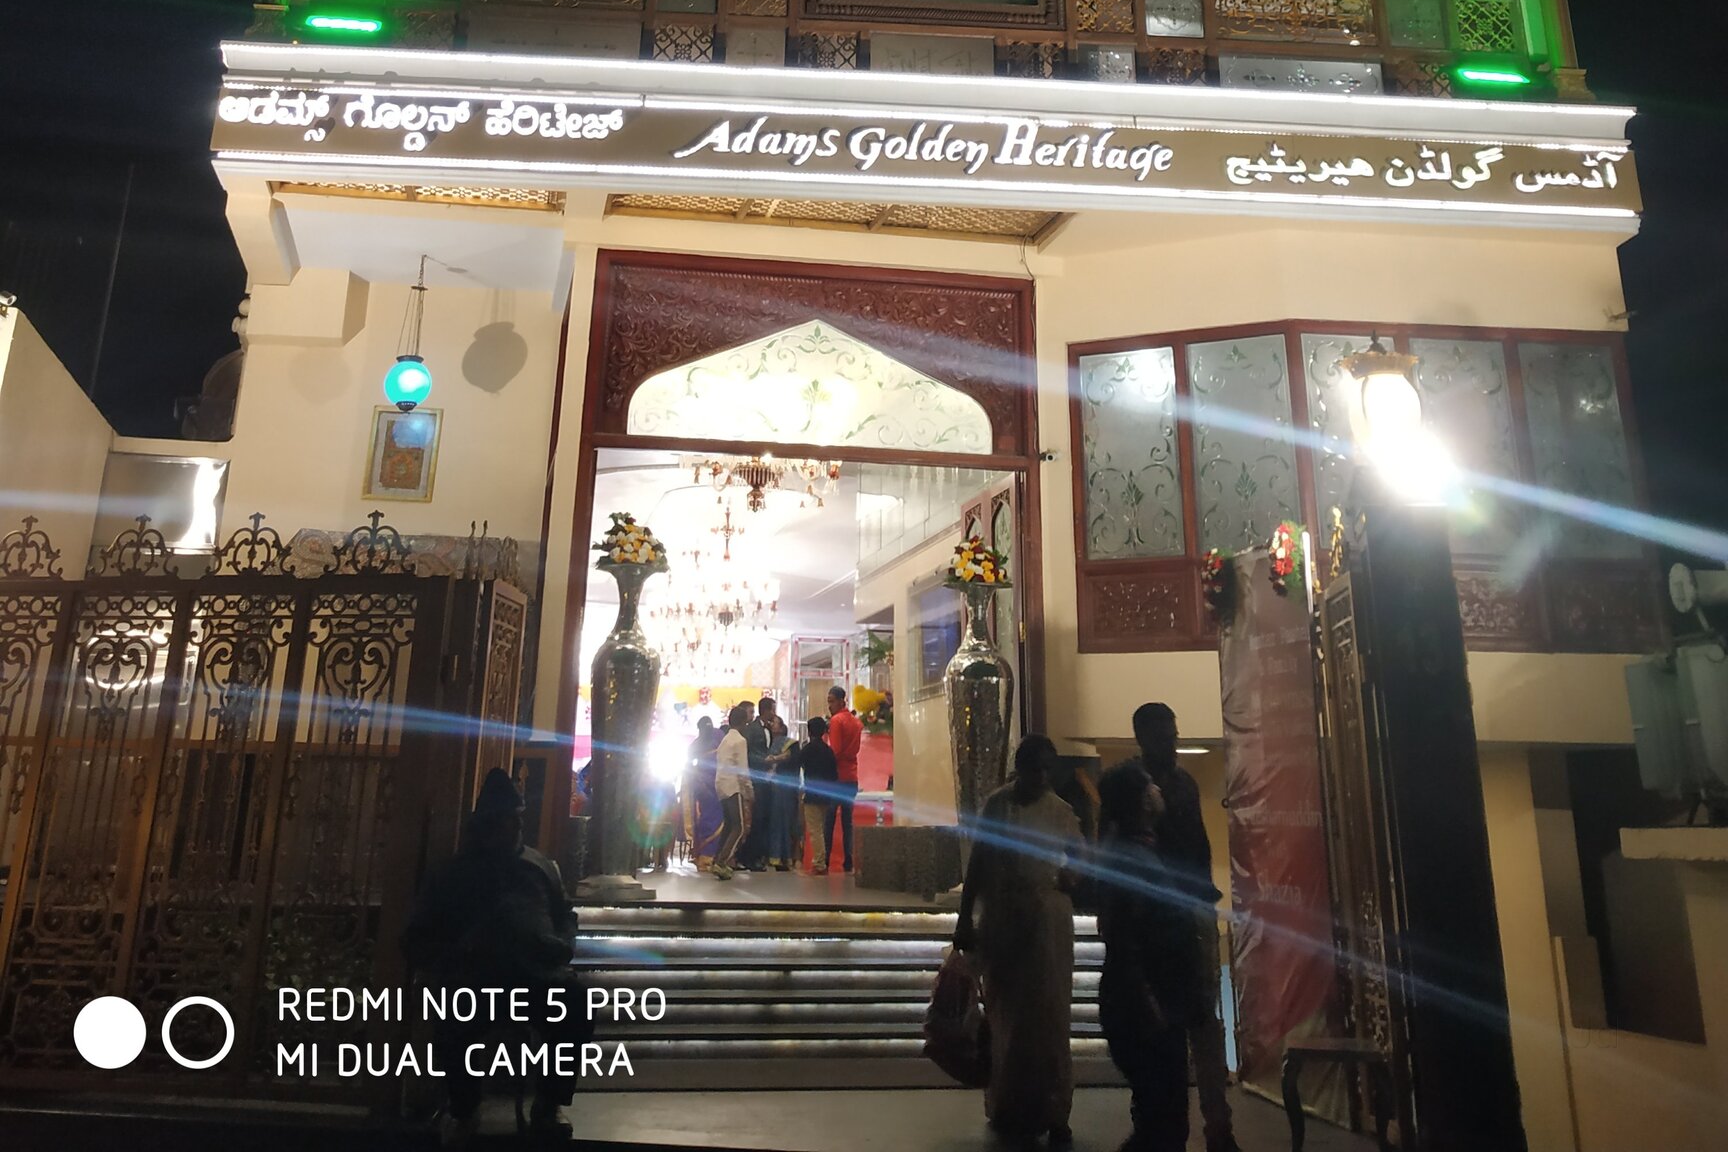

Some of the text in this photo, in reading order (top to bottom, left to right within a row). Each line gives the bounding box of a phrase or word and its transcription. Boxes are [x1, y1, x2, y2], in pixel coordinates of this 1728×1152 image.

[674, 115, 1174, 181] Adams Golden Heritage
[1383, 144, 1505, 190] گولڈن
